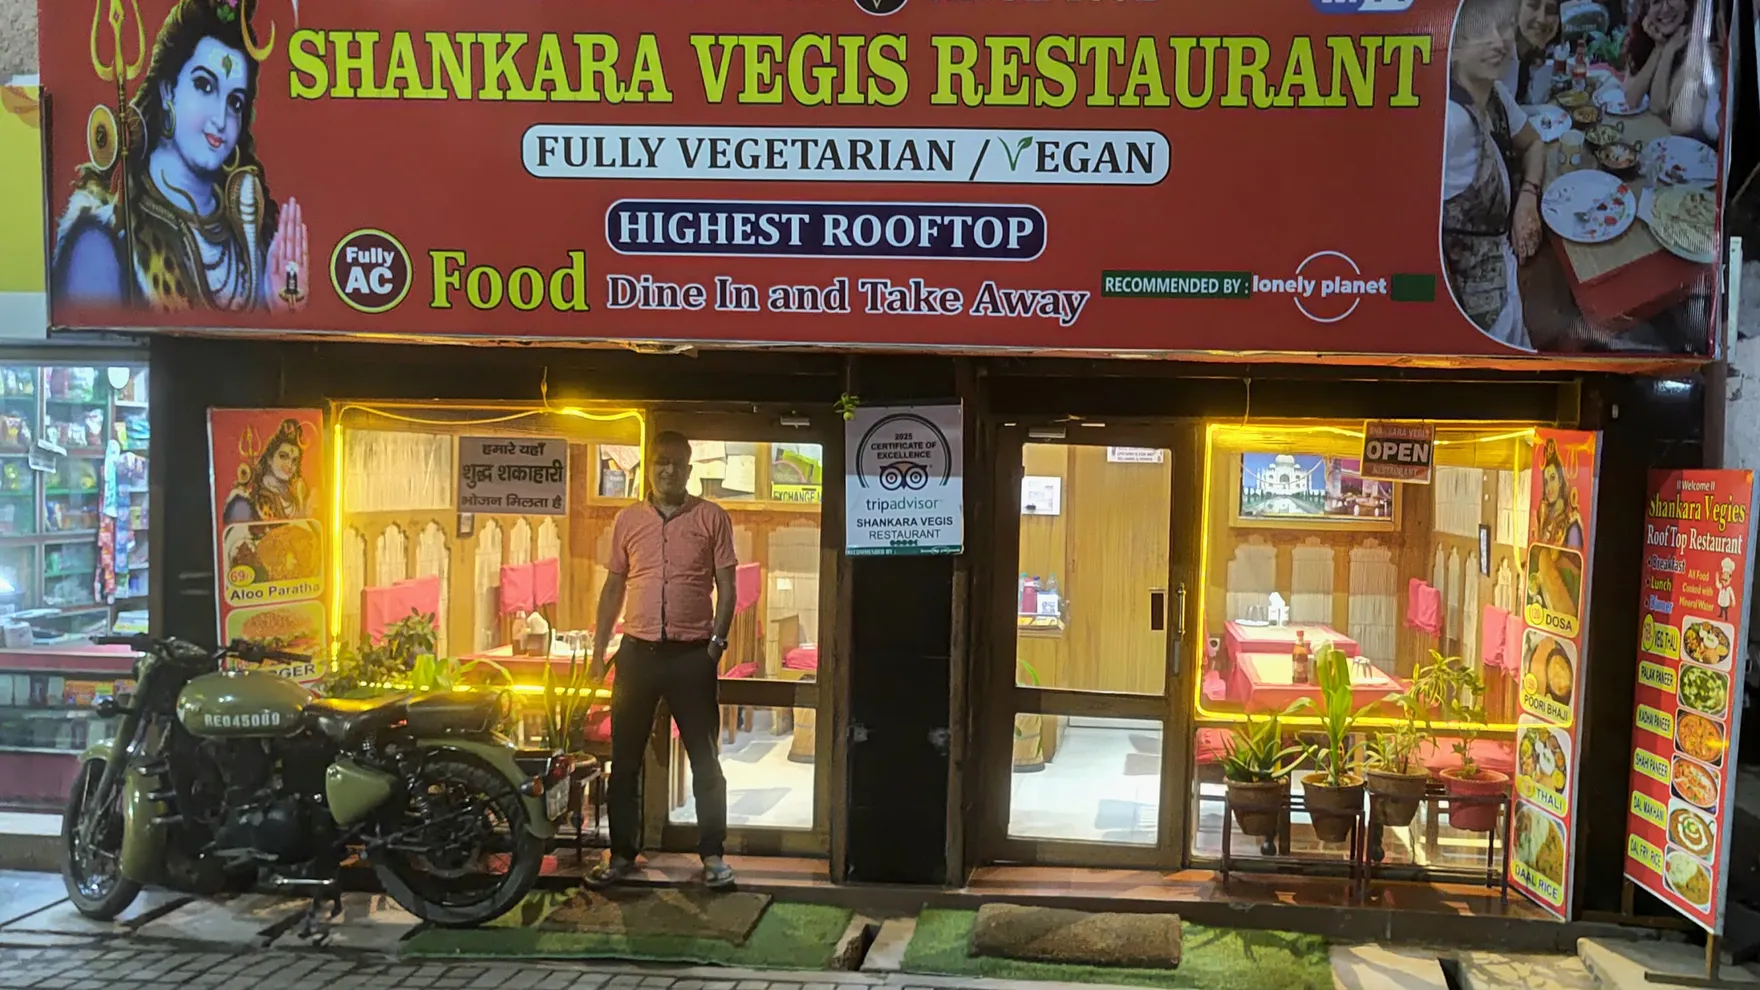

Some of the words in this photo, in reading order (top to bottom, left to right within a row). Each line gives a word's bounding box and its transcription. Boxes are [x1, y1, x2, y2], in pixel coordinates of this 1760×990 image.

[288, 29, 673, 104] SHANKARA
[689, 33, 910, 106] VEGIS
[930, 35, 1432, 109] RESTAURANT
[536, 136, 666, 168] FULLY
[677, 138, 955, 171] VEGETARIAN
[997, 136, 1155, 174] VEGAN
[618, 211, 810, 246] HIGHEST
[822, 214, 1034, 249] ROOFTOP
[346, 246, 395, 267] Fully
[345, 267, 393, 294] AC
[428, 249, 590, 312] Food
[1105, 277, 1219, 293] RECOMMENDED
[1223, 279, 1241, 294] BY
[1253, 275, 1315, 297] lonely
[1321, 276, 1387, 297] planet
[606, 274, 706, 310] Dine
[715, 277, 759, 311] In
[768, 278, 850, 313] and
[859, 278, 963, 315] Take
[970, 281, 1090, 326] Away
[482, 442, 516, 455] हमारे
[871, 442, 924, 450] CERTIFICATE
[877, 451, 931, 459] EXCELLENCE
[1366, 440, 1429, 462] OPEN
[462, 463, 494, 489] शुद्ध
[1681, 480, 1710, 492] Welcome
[461, 493, 502, 507] भोजन
[506, 493, 549, 508] मिलता
[552, 494, 562, 509] है
[866, 497, 939, 513] tripadvisor
[856, 517, 917, 528] SHANKARA
[920, 516, 953, 526] VEGIS
[1649, 493, 1701, 520] Shankara
[1704, 495, 1746, 531] Vegies
[869, 529, 941, 540] RESTAURANT
[1647, 524, 1670, 547] Roof
[1670, 526, 1688, 555] Top
[1689, 528, 1742, 554] Restaurant
[1652, 554, 1686, 574] Breakfast
[231, 588, 264, 601] Aloo
[268, 582, 320, 597] Paratha
[1650, 576, 1672, 592] Lunch
[1545, 613, 1572, 632] DOSA
[1524, 694, 1545, 712] POORI
[1547, 703, 1568, 721] BHAJI
[1536, 788, 1562, 811] THALI
[1515, 863, 1536, 887] DAAL
[1538, 878, 1558, 900] RICE
